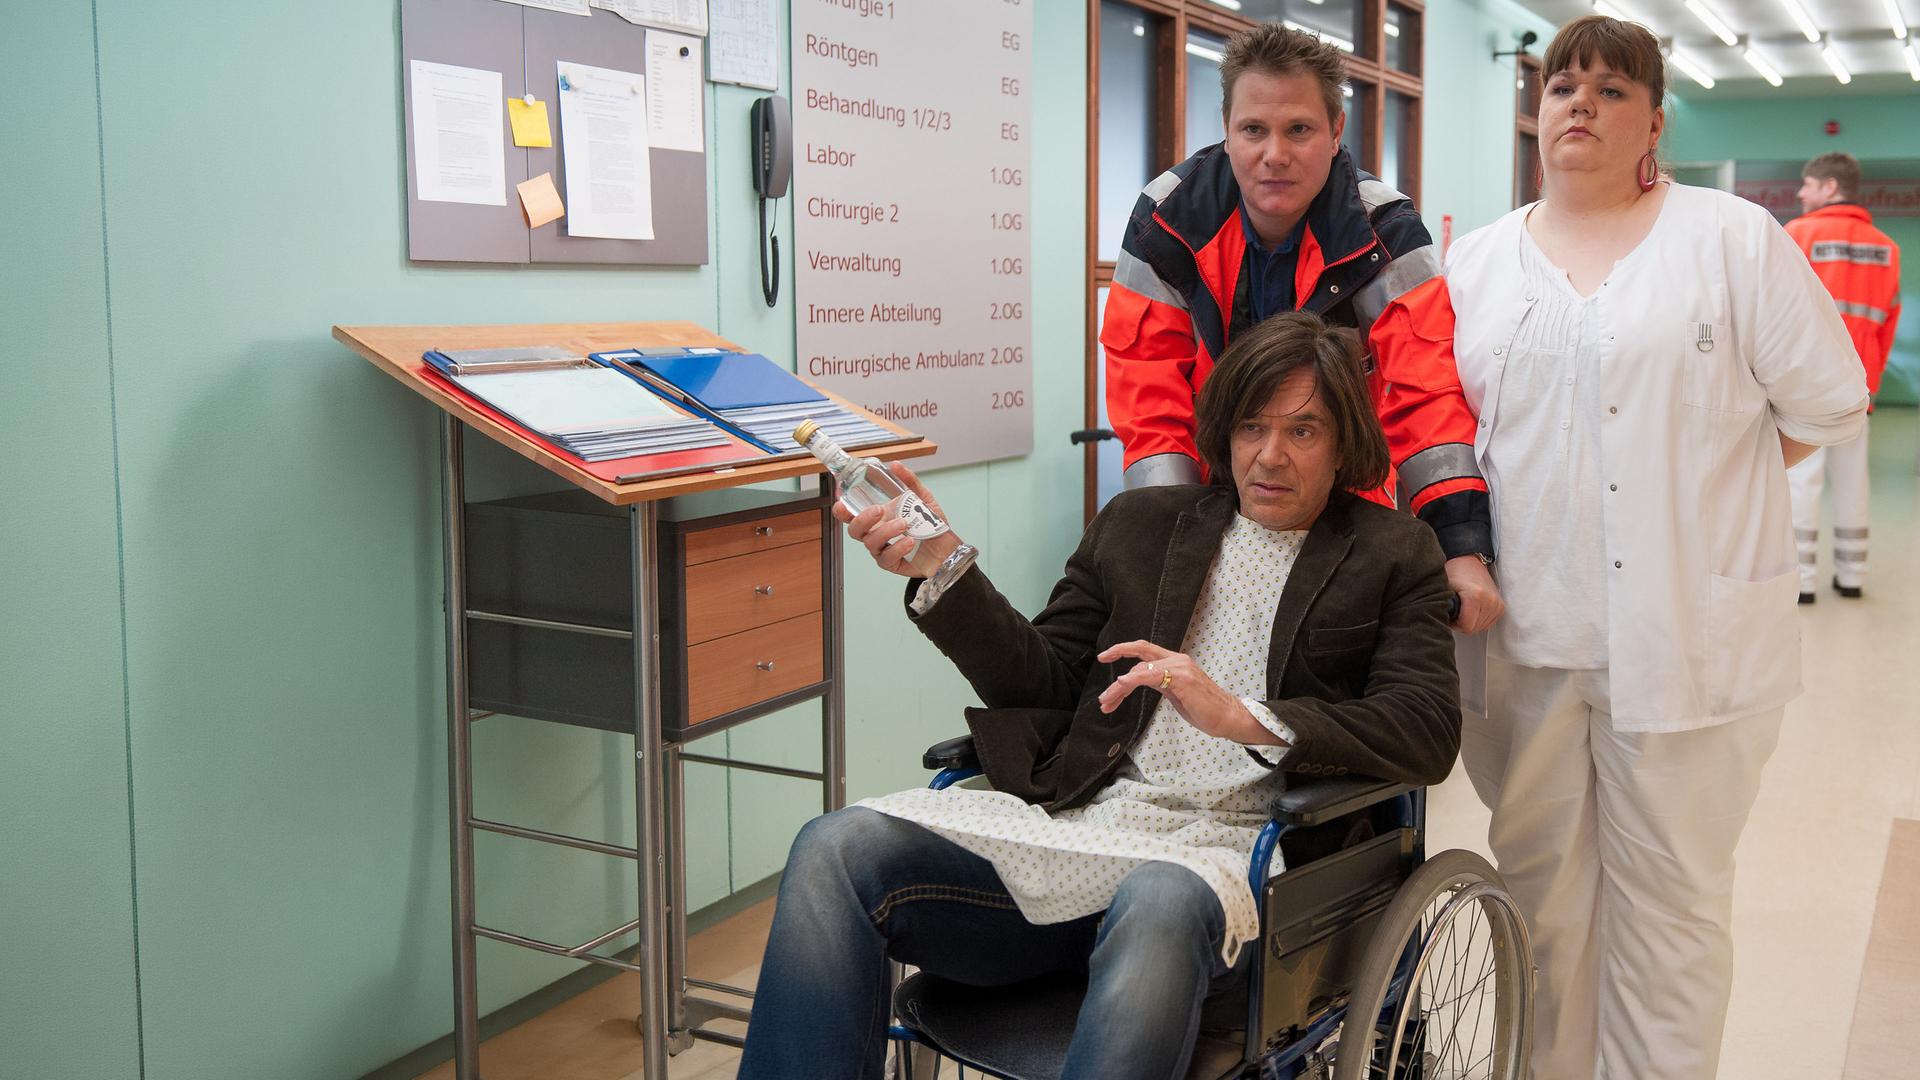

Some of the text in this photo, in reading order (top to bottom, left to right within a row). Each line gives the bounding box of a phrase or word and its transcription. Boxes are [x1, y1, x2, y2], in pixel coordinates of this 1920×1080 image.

[887, 1, 895, 20] 1
[1001, 30, 1021, 52] EG
[806, 33, 1020, 97] Röntgen EG
[806, 88, 1019, 142] Behandlung 1/2/3 EG
[807, 143, 1022, 187] Labor 1.OG
[807, 197, 1023, 231] Chirurgie 2 1.OG
[807, 250, 1023, 278] Verwaltung 1.OG
[808, 302, 1023, 326] Innere Abteilung 2.OG
[809, 346, 1024, 378] Chirurgische Ambulanz 2.OG
[991, 389, 1025, 410] 2.OG
